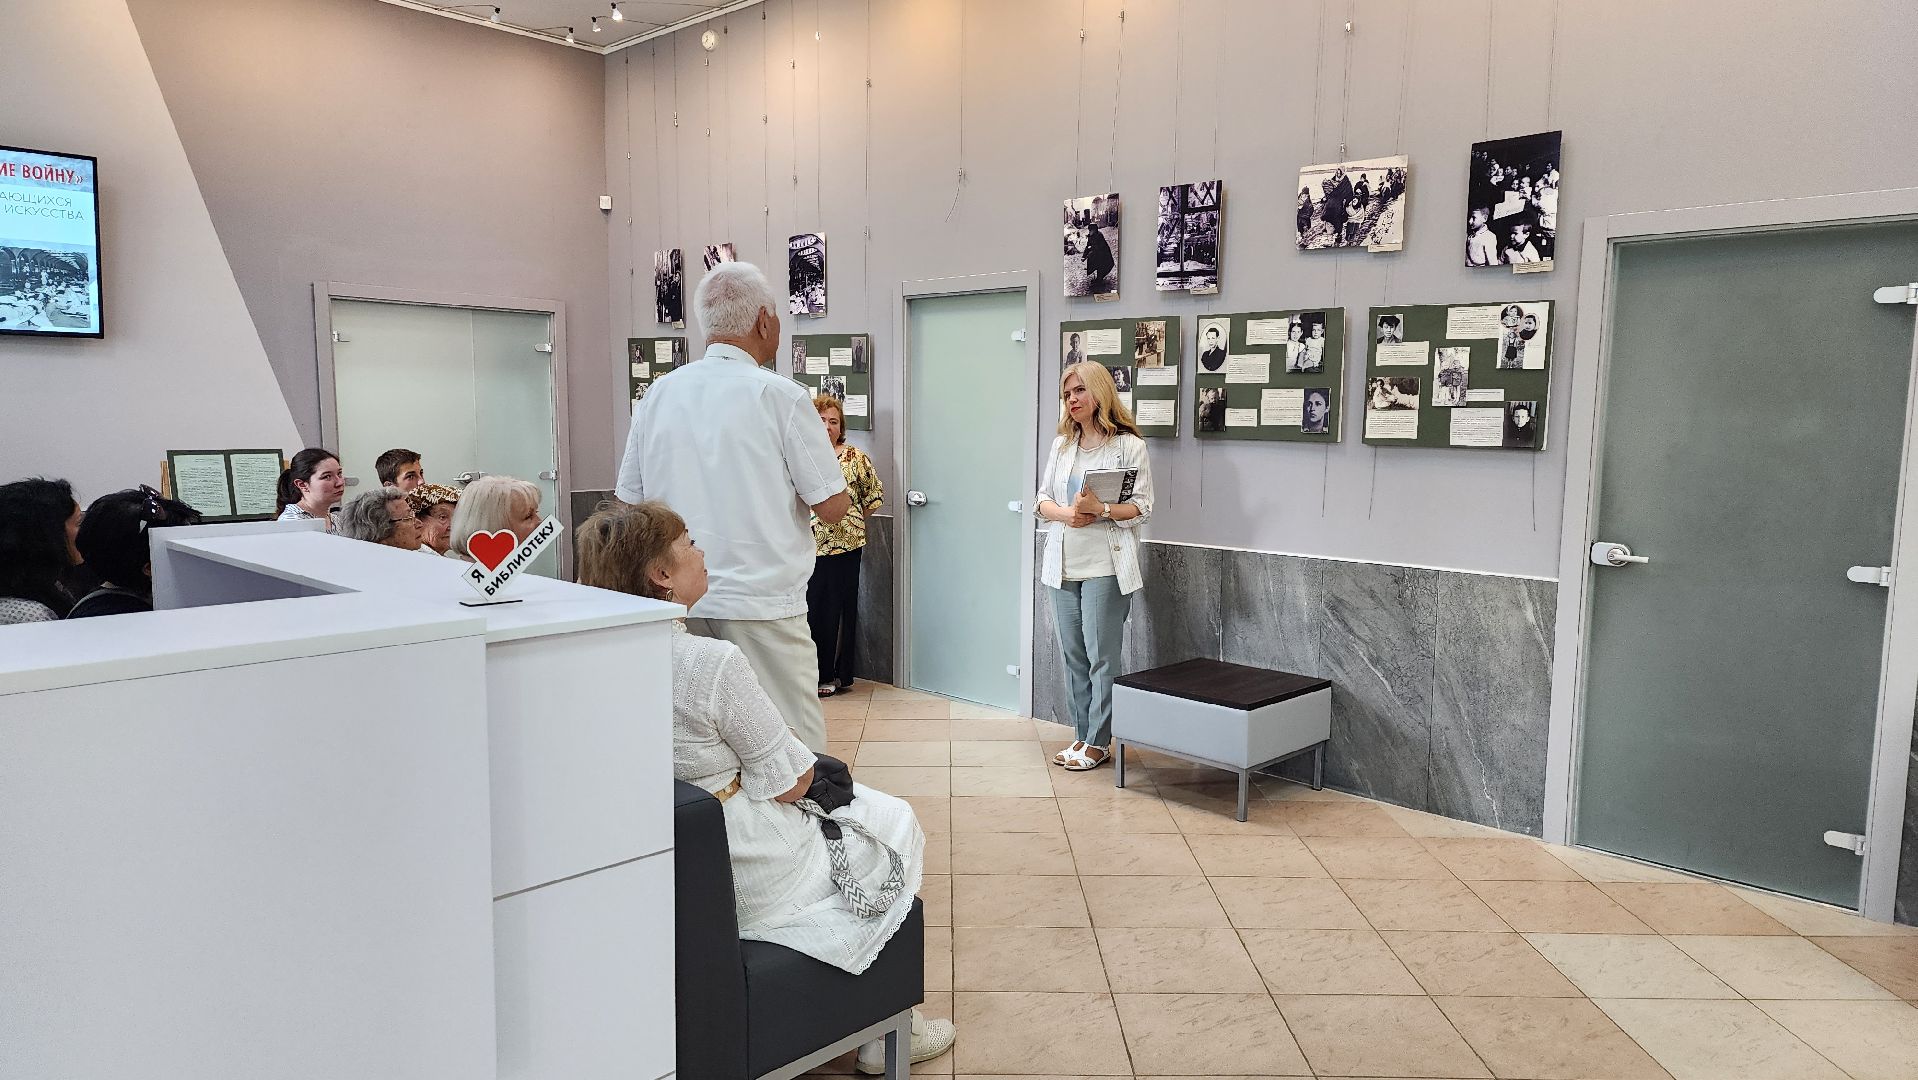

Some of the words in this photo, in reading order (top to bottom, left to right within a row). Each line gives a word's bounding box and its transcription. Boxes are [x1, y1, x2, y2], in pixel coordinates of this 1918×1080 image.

[22, 164, 83, 184] ВОЙНУ»
[5, 204, 84, 220] ИСКУССТВА
[485, 521, 554, 596] БИБЛИОТЕКУ
[471, 568, 485, 583] Я
